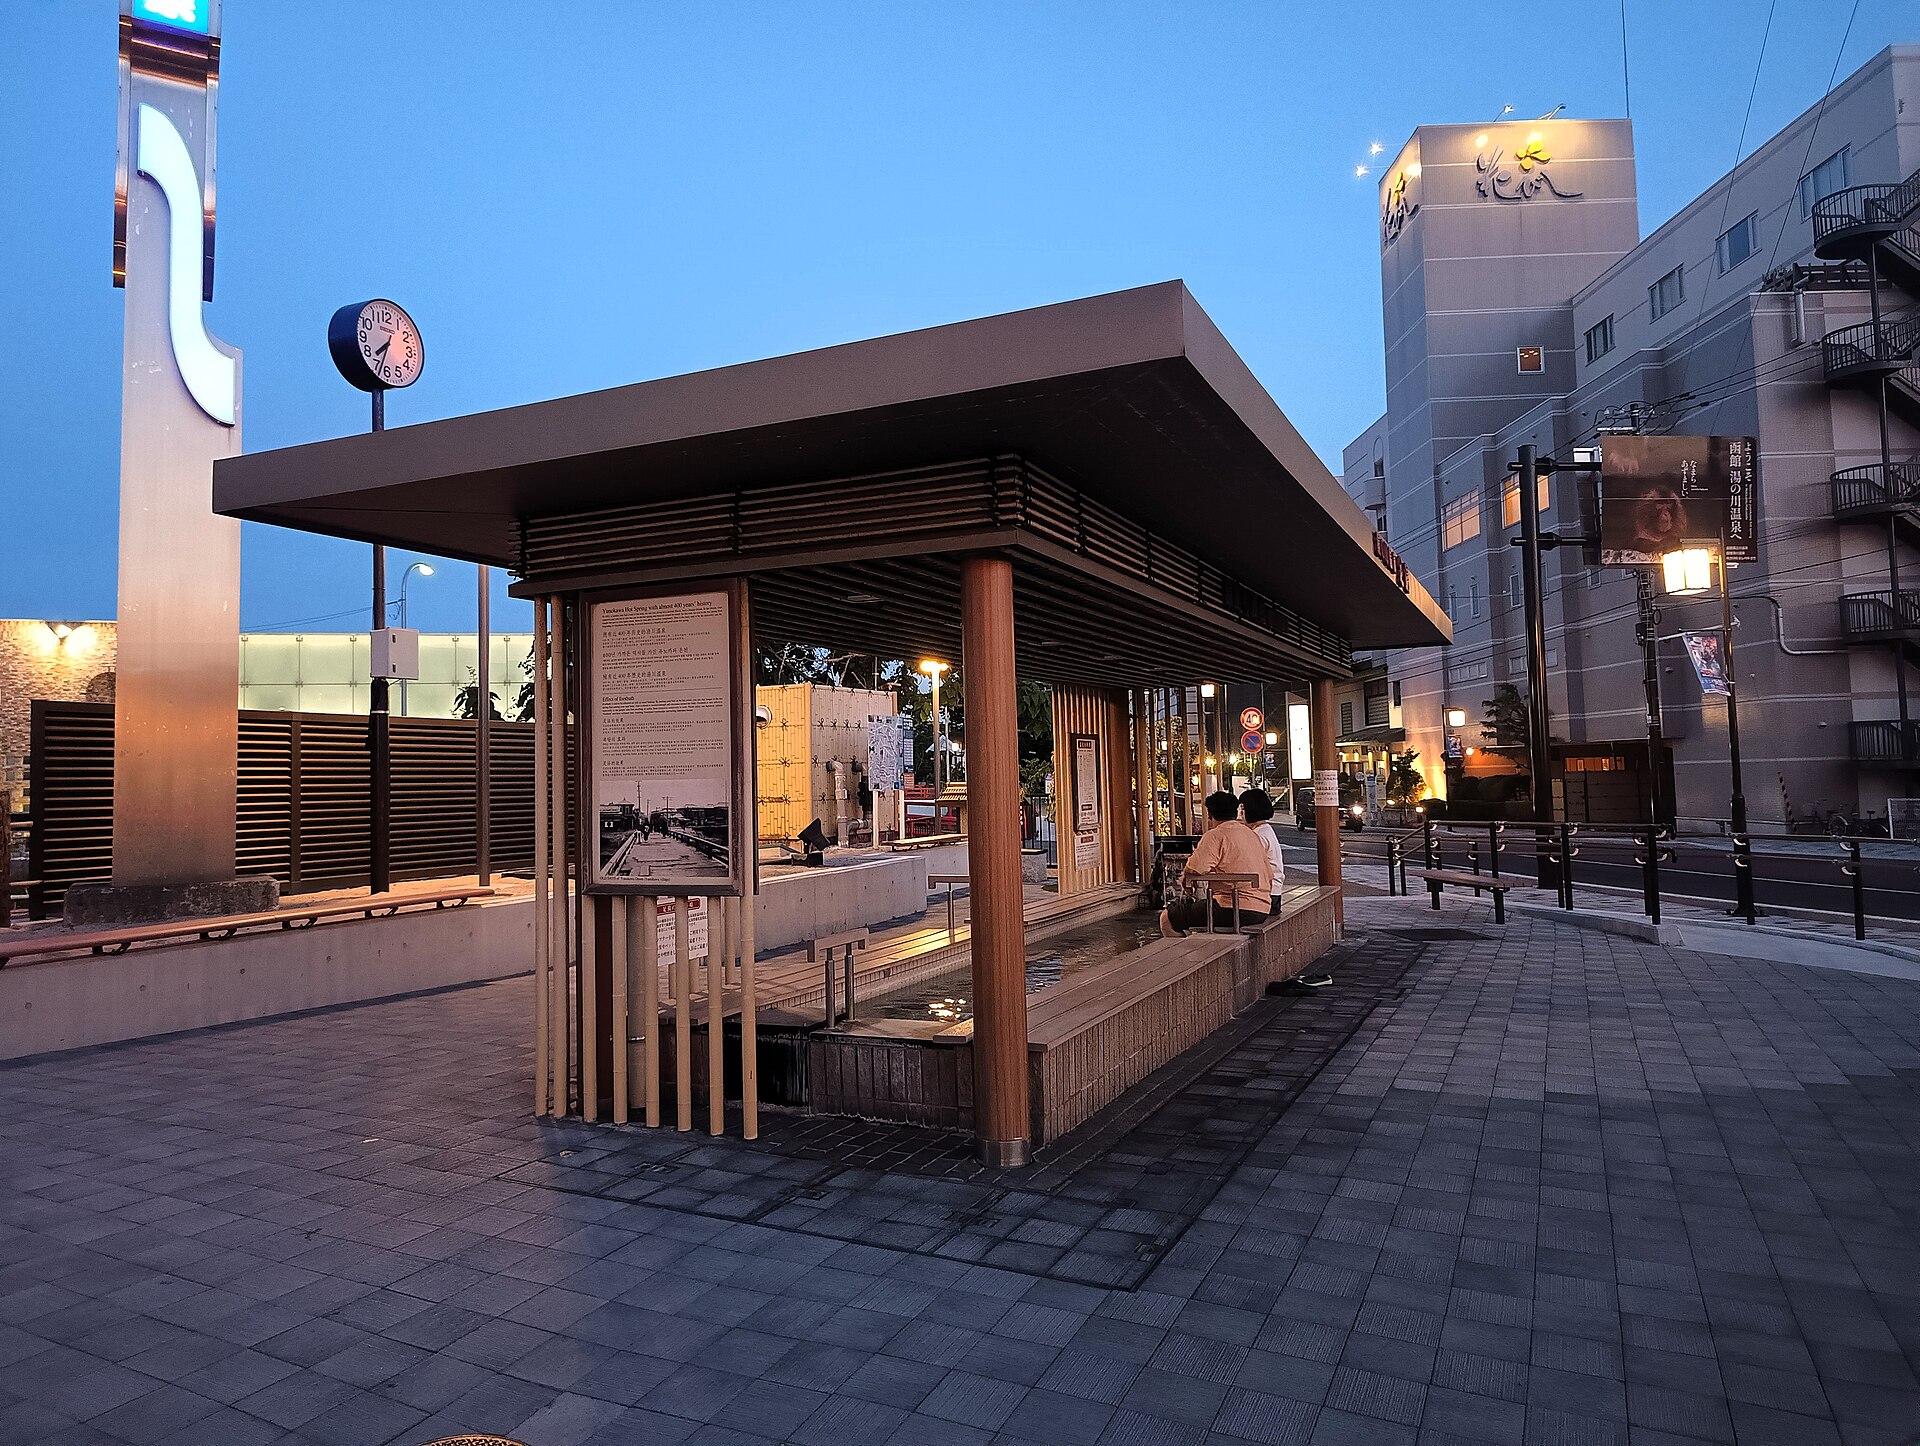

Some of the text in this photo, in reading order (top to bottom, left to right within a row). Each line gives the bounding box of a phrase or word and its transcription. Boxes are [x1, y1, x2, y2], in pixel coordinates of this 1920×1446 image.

[372, 309, 380, 324] 11
[381, 310, 392, 325] 12
[361, 316, 373, 331] 10
[359, 330, 367, 343] 9
[402, 331, 410, 344] 2
[363, 344, 372, 358] 8
[405, 346, 413, 359] 3
[372, 358, 381, 371] 7
[402, 359, 410, 371] 4
[383, 365, 391, 379] 6
[394, 365, 403, 378] 5
[1744, 441, 1753, 482] ようこそ
